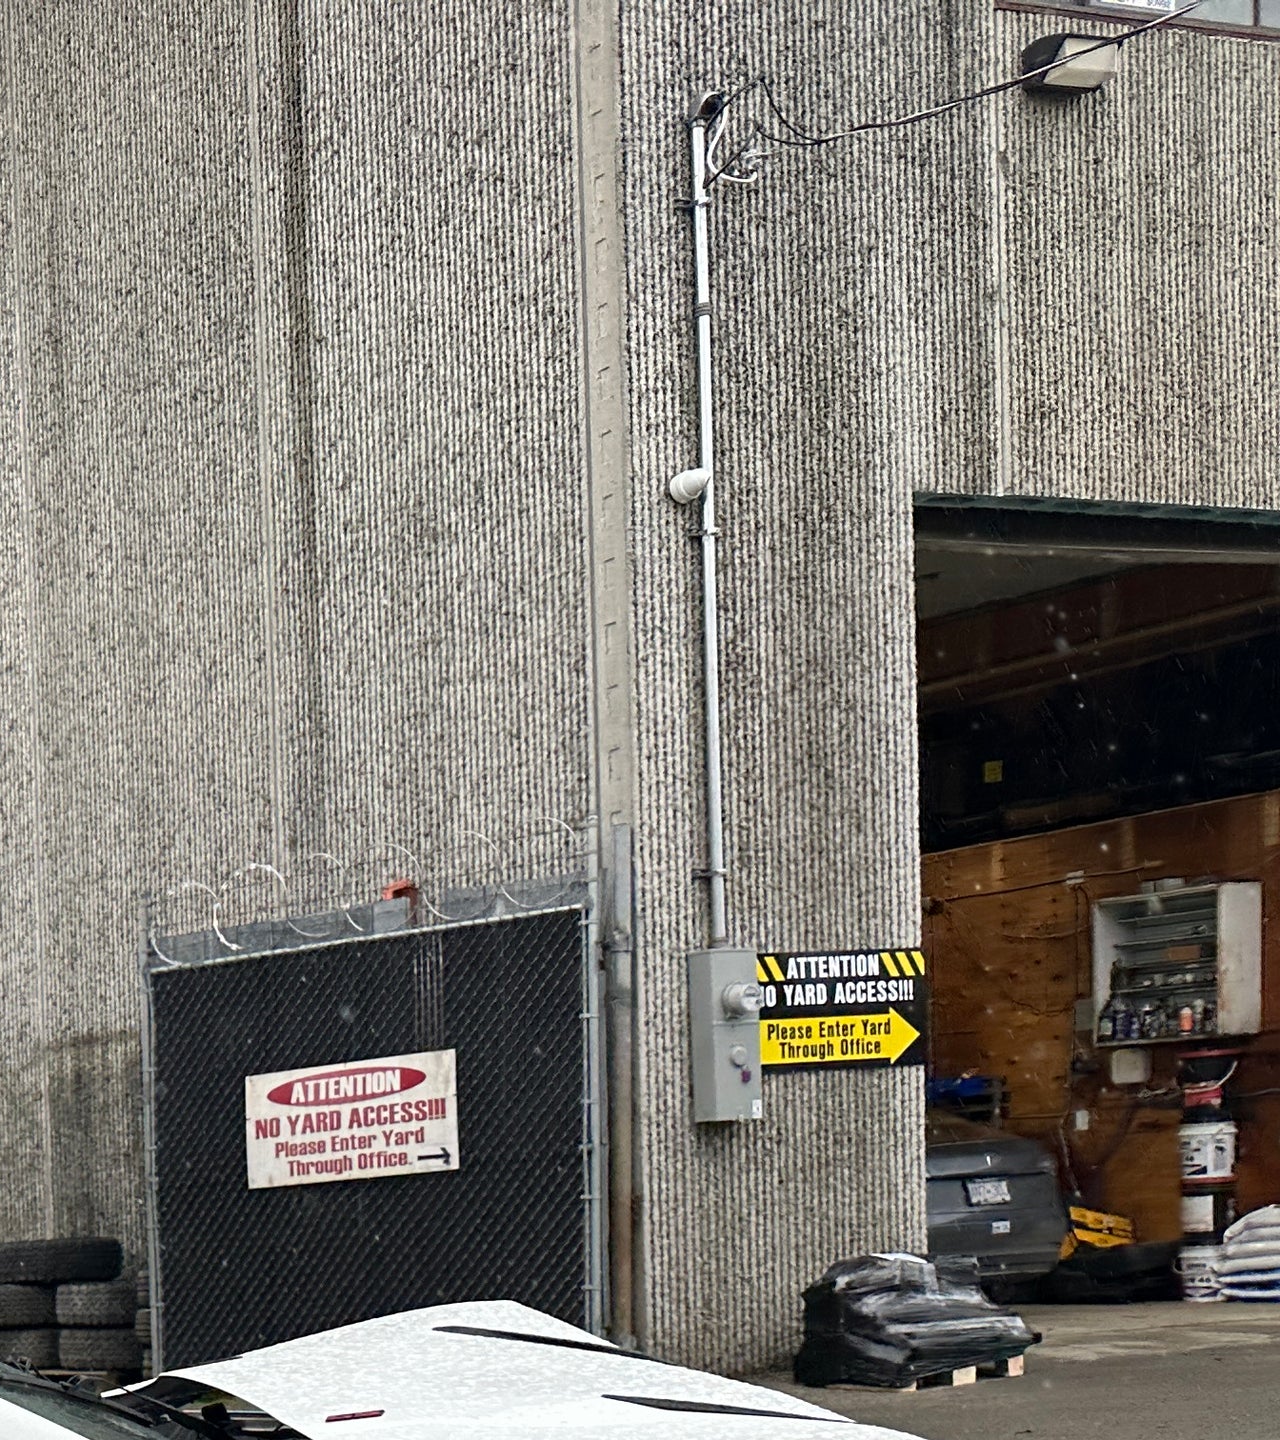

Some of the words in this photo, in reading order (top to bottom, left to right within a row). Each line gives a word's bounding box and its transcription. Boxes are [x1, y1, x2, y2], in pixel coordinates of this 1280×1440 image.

[786, 953, 881, 980] ATTENTION
[782, 982, 828, 1007] YARD
[833, 978, 915, 1006] ACCESS!!!
[766, 1022, 813, 1042] Please
[818, 1020, 856, 1039] Enter
[860, 1016, 892, 1037] Yard
[778, 1040, 835, 1061] Through
[839, 1037, 882, 1057] Office
[289, 1068, 402, 1105] ATTENTION
[254, 1116, 282, 1141] NO
[286, 1109, 342, 1136] YARD
[348, 1097, 447, 1130] ACCESS!!!
[274, 1138, 327, 1159] Please
[330, 1132, 378, 1154] Enter
[381, 1125, 426, 1147] Yard
[287, 1154, 354, 1178] Through
